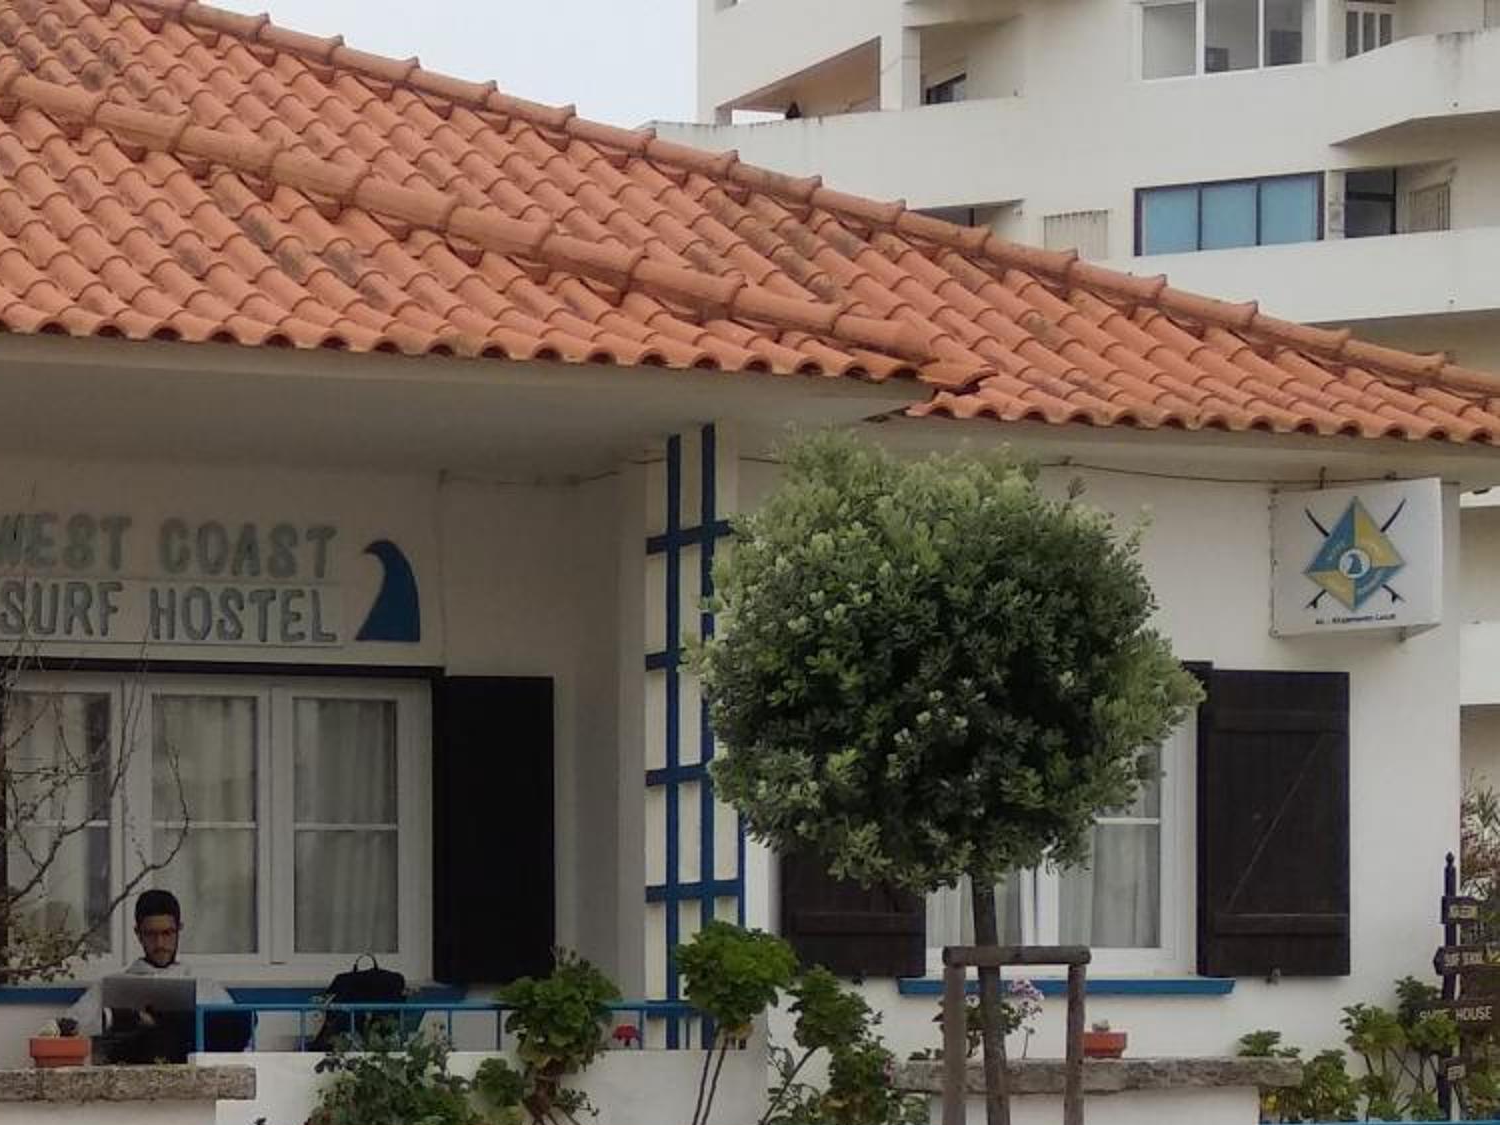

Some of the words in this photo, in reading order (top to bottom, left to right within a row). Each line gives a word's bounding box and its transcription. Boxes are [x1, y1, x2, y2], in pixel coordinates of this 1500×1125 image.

[159, 517, 338, 579] COAST
[0, 580, 123, 636] SURF
[150, 586, 337, 643] HOSTEL
[1455, 1006, 1492, 1022] HOUSE
